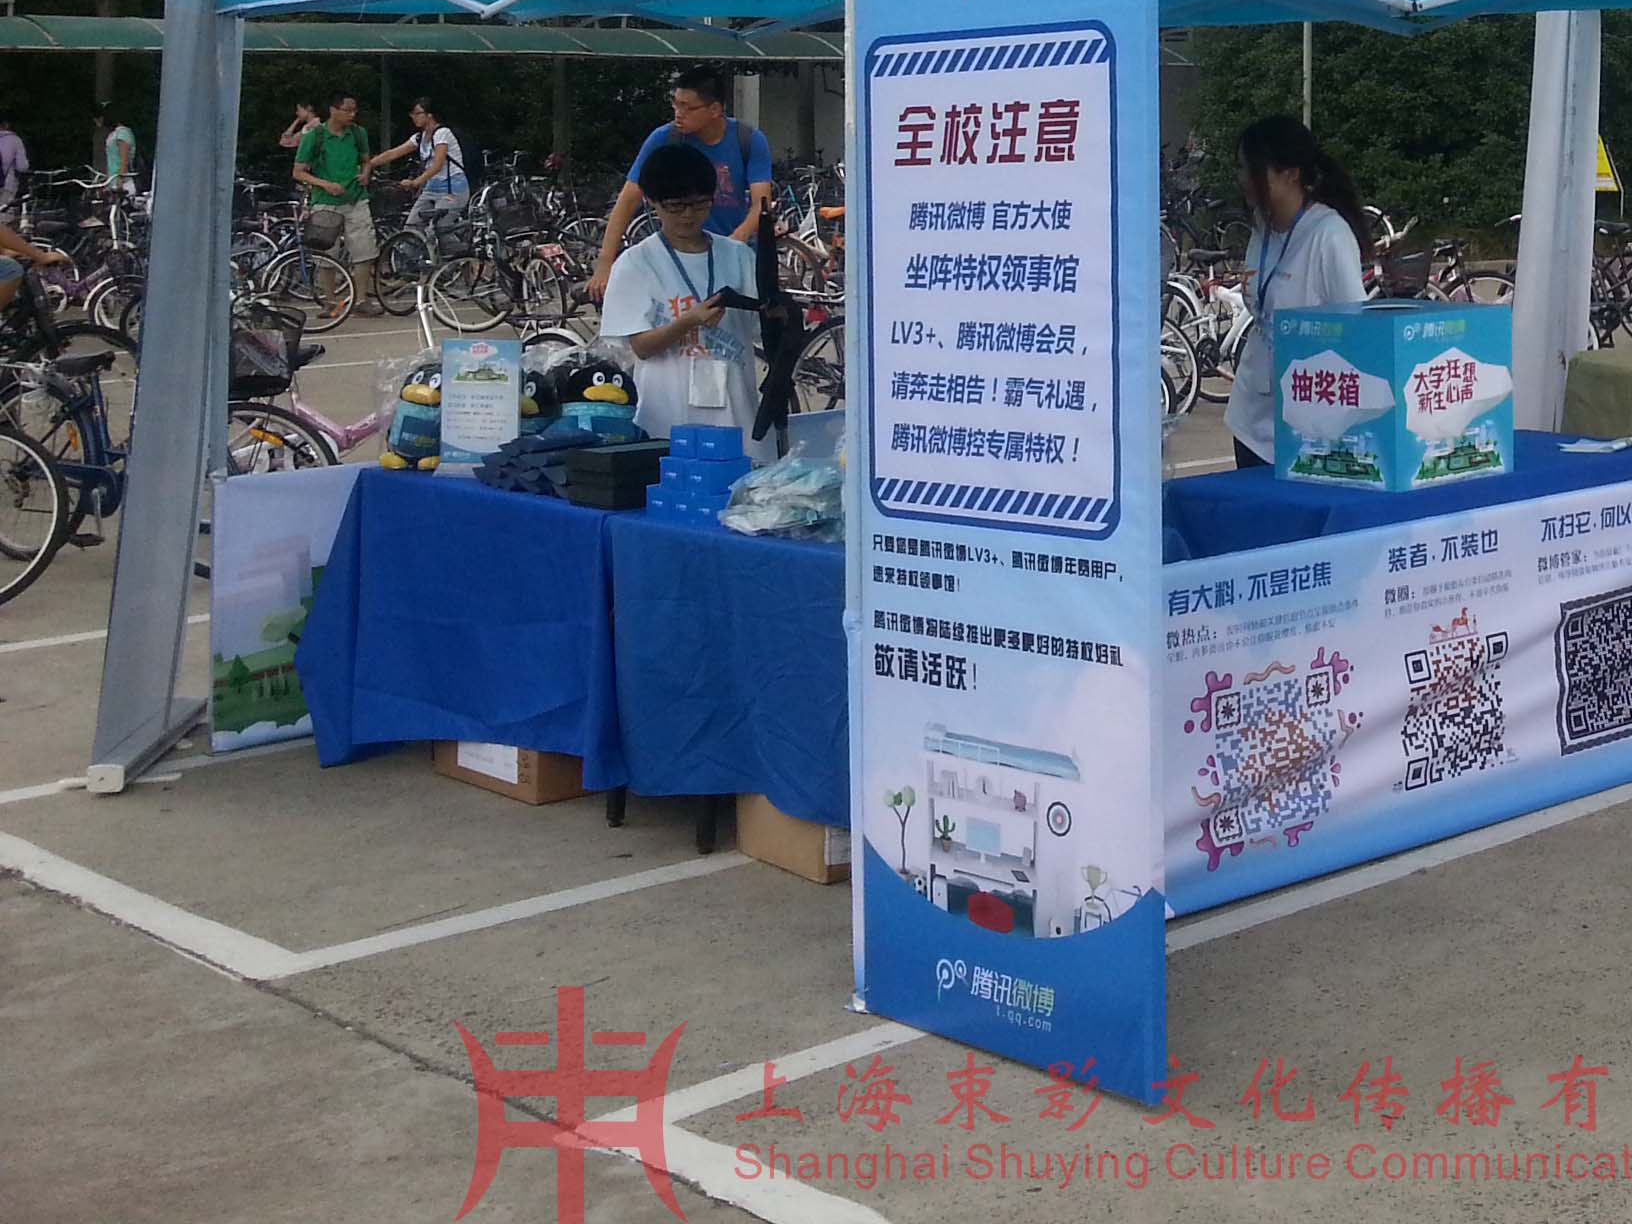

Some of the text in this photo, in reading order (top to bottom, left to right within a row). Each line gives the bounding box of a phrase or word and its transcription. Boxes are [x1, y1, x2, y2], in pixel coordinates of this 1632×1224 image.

[894, 99, 1080, 166] 全校注意
[909, 200, 1072, 231] 腾讯微博 官方大使
[904, 253, 1080, 293] 坐阵特权领事馆
[1292, 368, 1360, 408] 抽奖箱
[874, 643, 977, 691] 敬请活跃！
[971, 966, 1056, 1017] 腾讯微博
[996, 1004, 1053, 1033] t.qq.com
